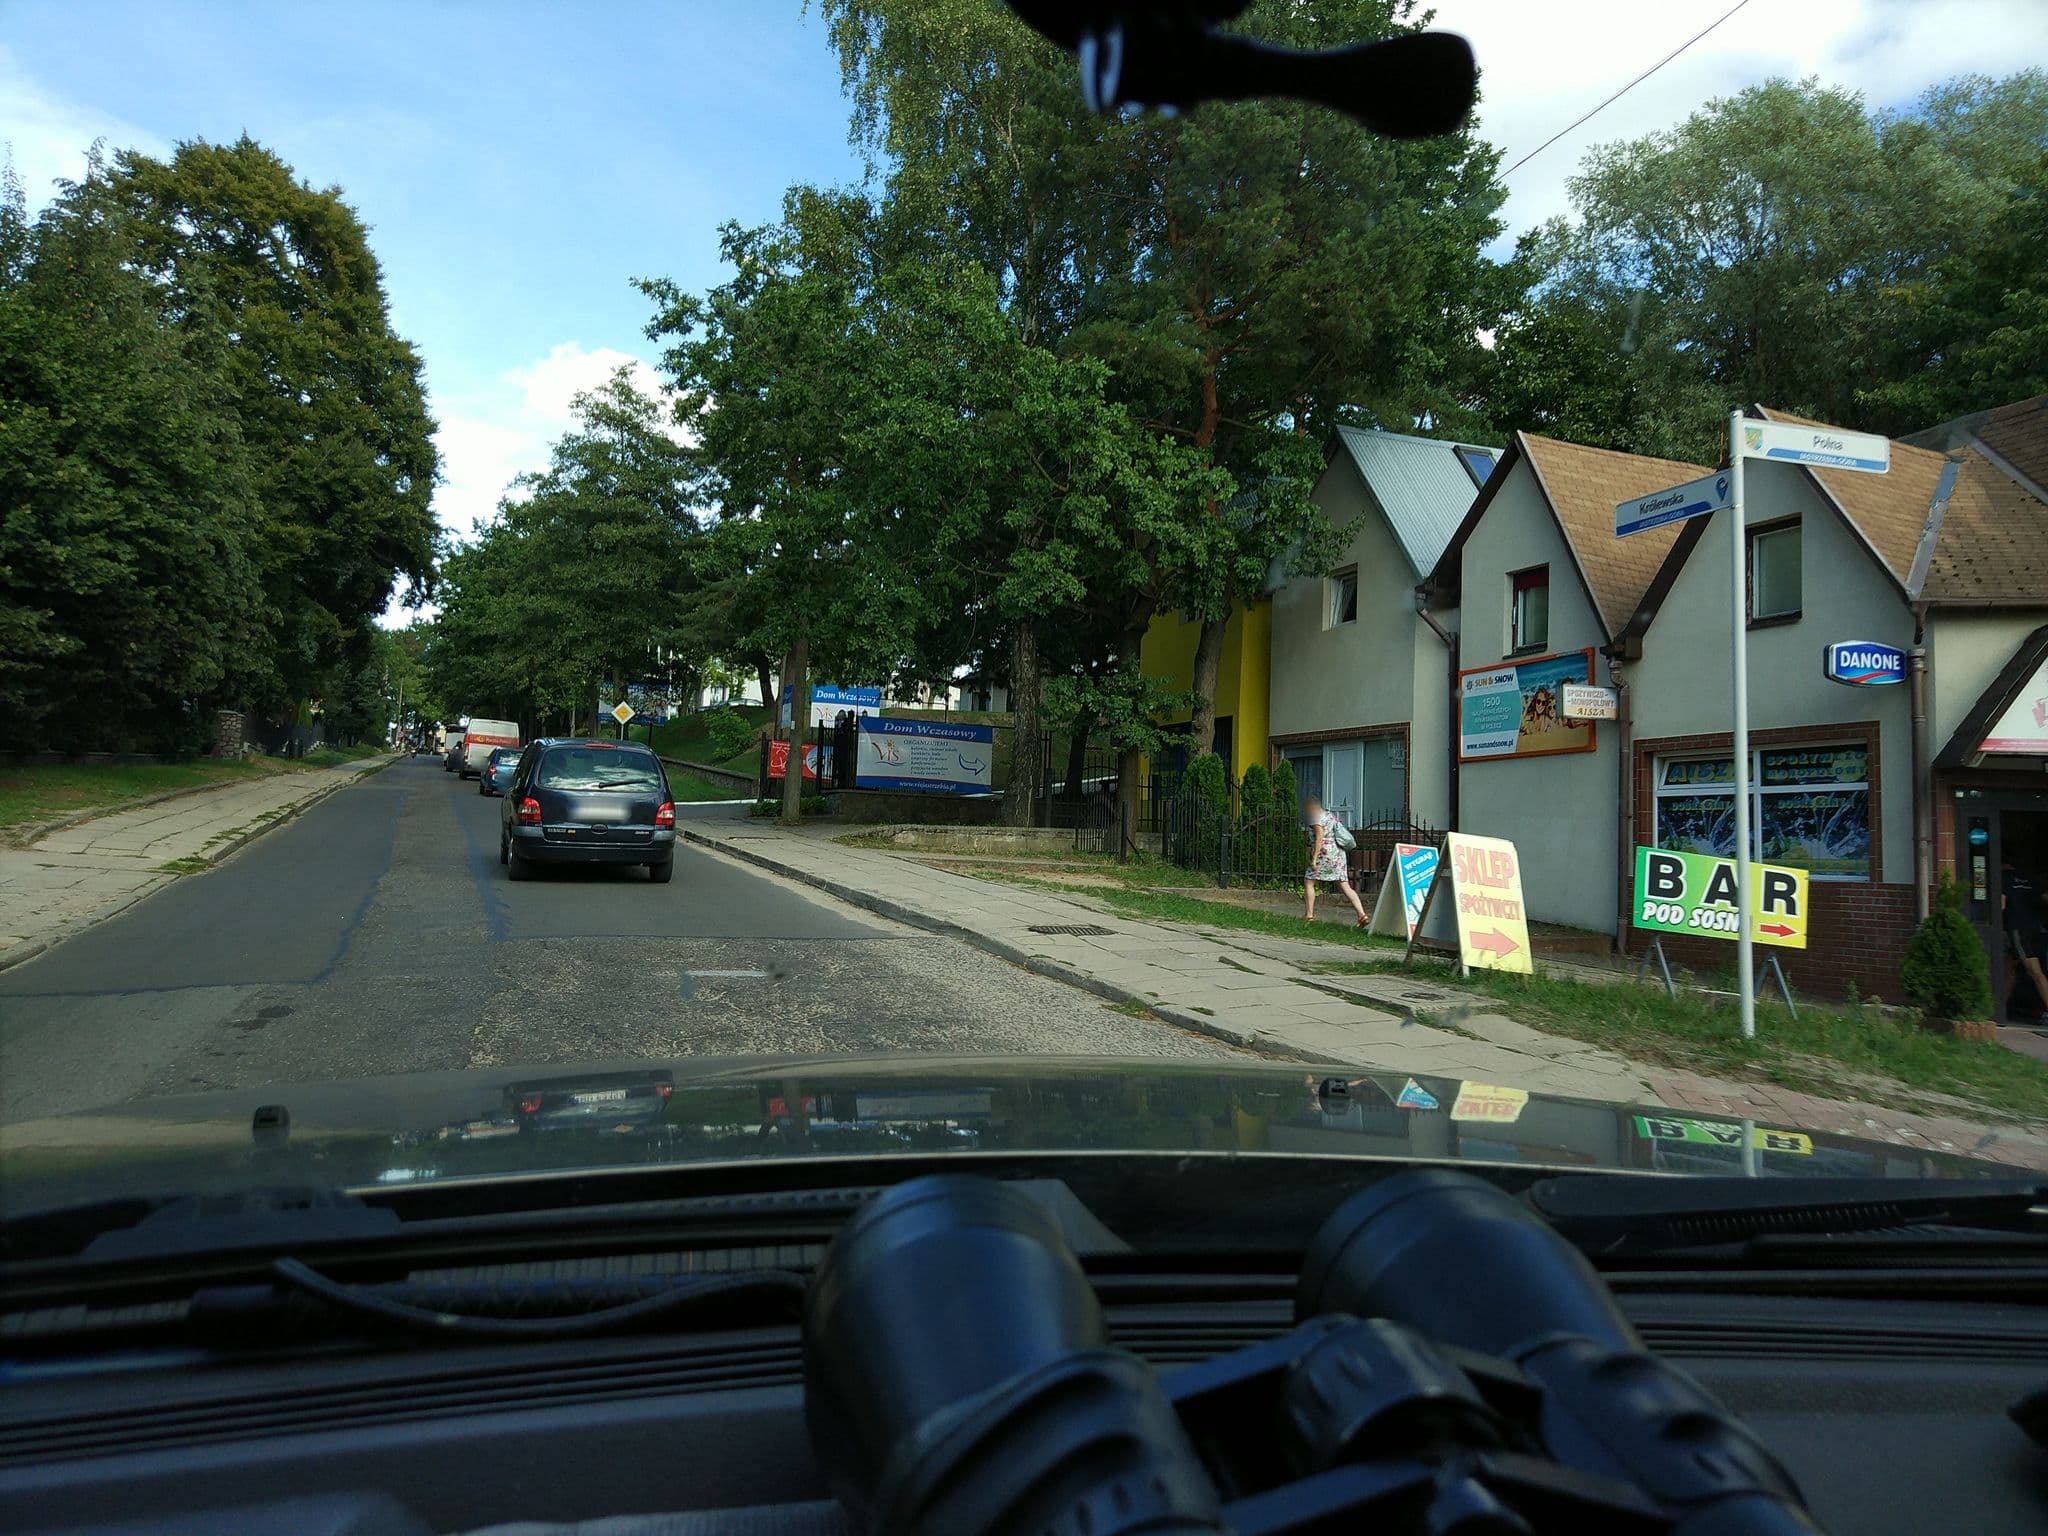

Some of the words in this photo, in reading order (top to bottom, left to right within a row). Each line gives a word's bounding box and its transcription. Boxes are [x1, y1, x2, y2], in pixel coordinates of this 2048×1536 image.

[1813, 436, 1843, 450] Polna
[1640, 493, 1684, 515] Królewska
[1840, 651, 1901, 670] DANONE
[1474, 677, 1487, 688] SUN
[1494, 673, 1514, 684] SNOW
[816, 690, 836, 699] Dom
[1482, 696, 1501, 708] 1500
[1576, 708, 1606, 716] AISZA
[884, 722, 913, 733] Dom
[917, 725, 977, 738] Wczasowy
[1454, 844, 1515, 889] SKLEP
[1644, 852, 1800, 918] BAR
[1459, 890, 1521, 920] SPOŻYWCZY
[1642, 902, 1686, 925] POD
[1688, 908, 1740, 932] SOSN
